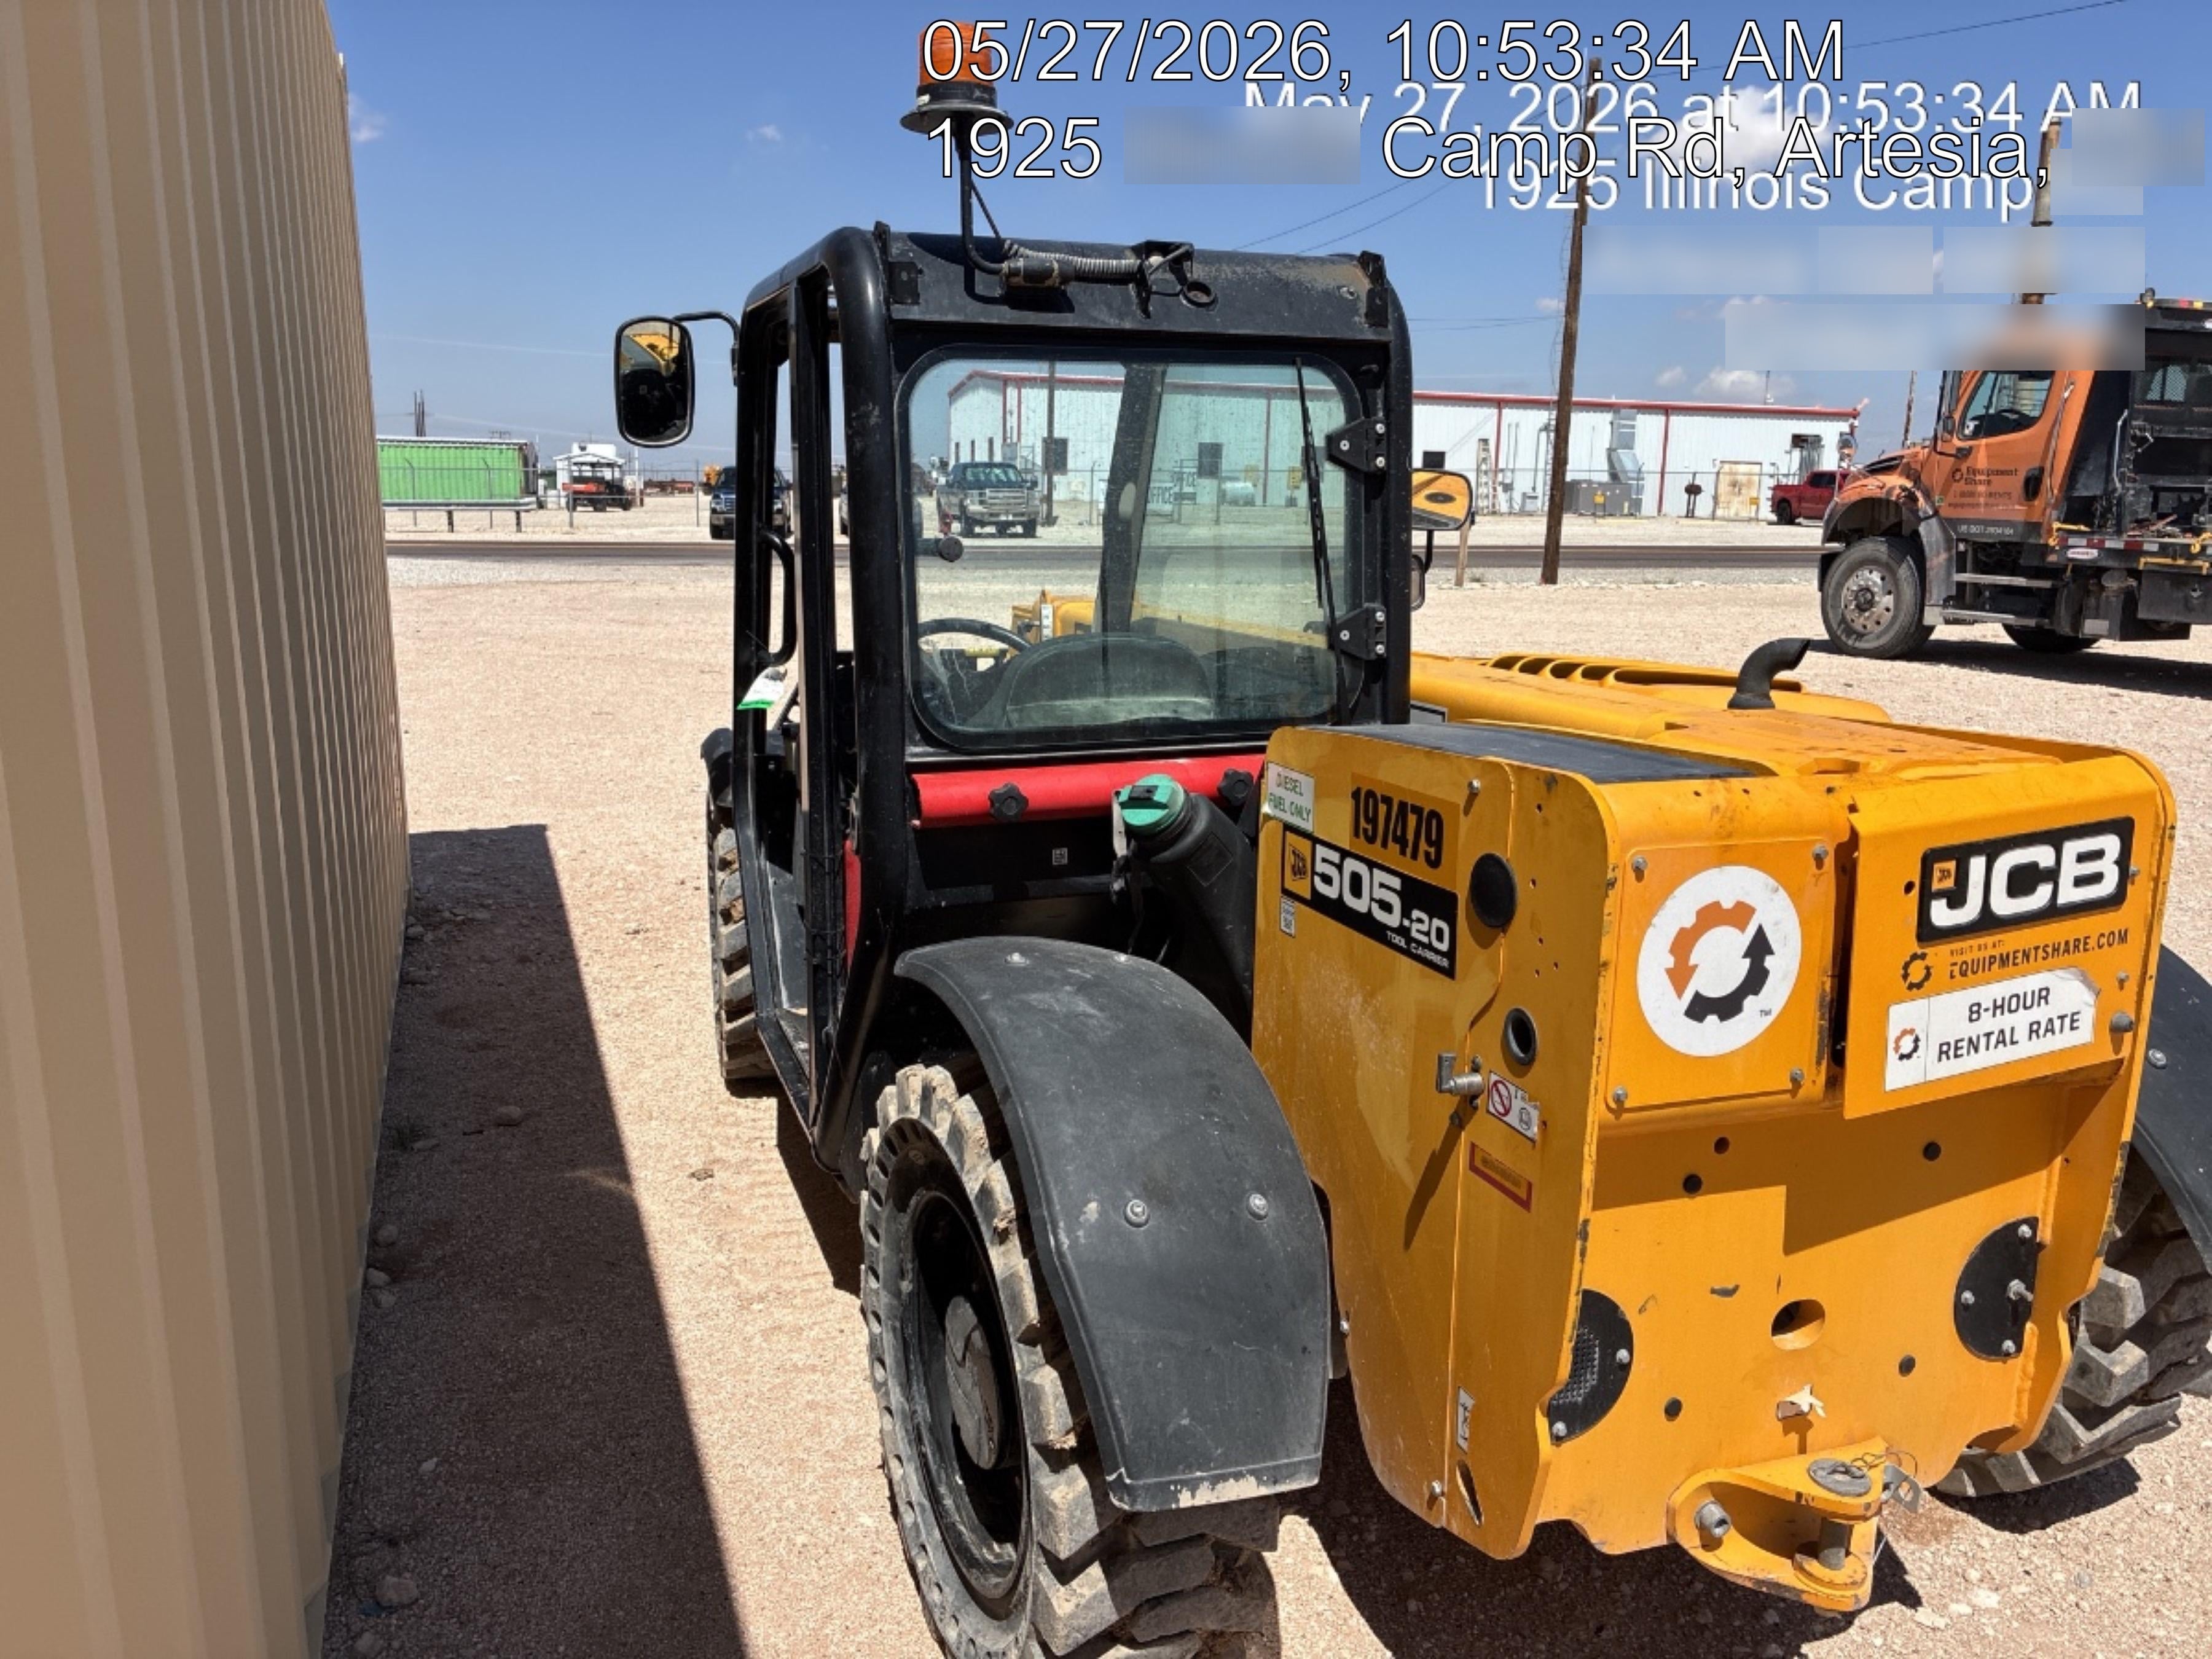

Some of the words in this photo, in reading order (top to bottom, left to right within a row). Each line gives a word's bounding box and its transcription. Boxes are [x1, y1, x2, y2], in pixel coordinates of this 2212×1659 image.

[1965, 477, 1993, 486] Share
[1967, 466, 2017, 477] Equipment
[1276, 772, 1304, 797] DIESEL
[1268, 792, 1287, 814] FUEL
[1290, 801, 1311, 823] ONLY
[1351, 786, 1445, 869] 197479
[1314, 843, 1451, 952] 505-20
[1929, 834, 2120, 929] JCB
[1386, 930, 1407, 948] TOOL
[1410, 943, 1449, 968] CARRIER
[1949, 928, 2128, 979] EQUIPMENTSHARE.COM
[1950, 945, 1973, 957] VISIT
[1968, 986, 2051, 1024] 8-HOUR
[1937, 1026, 2020, 1064] RENTAL
[2028, 1011, 2082, 1044] RATE
